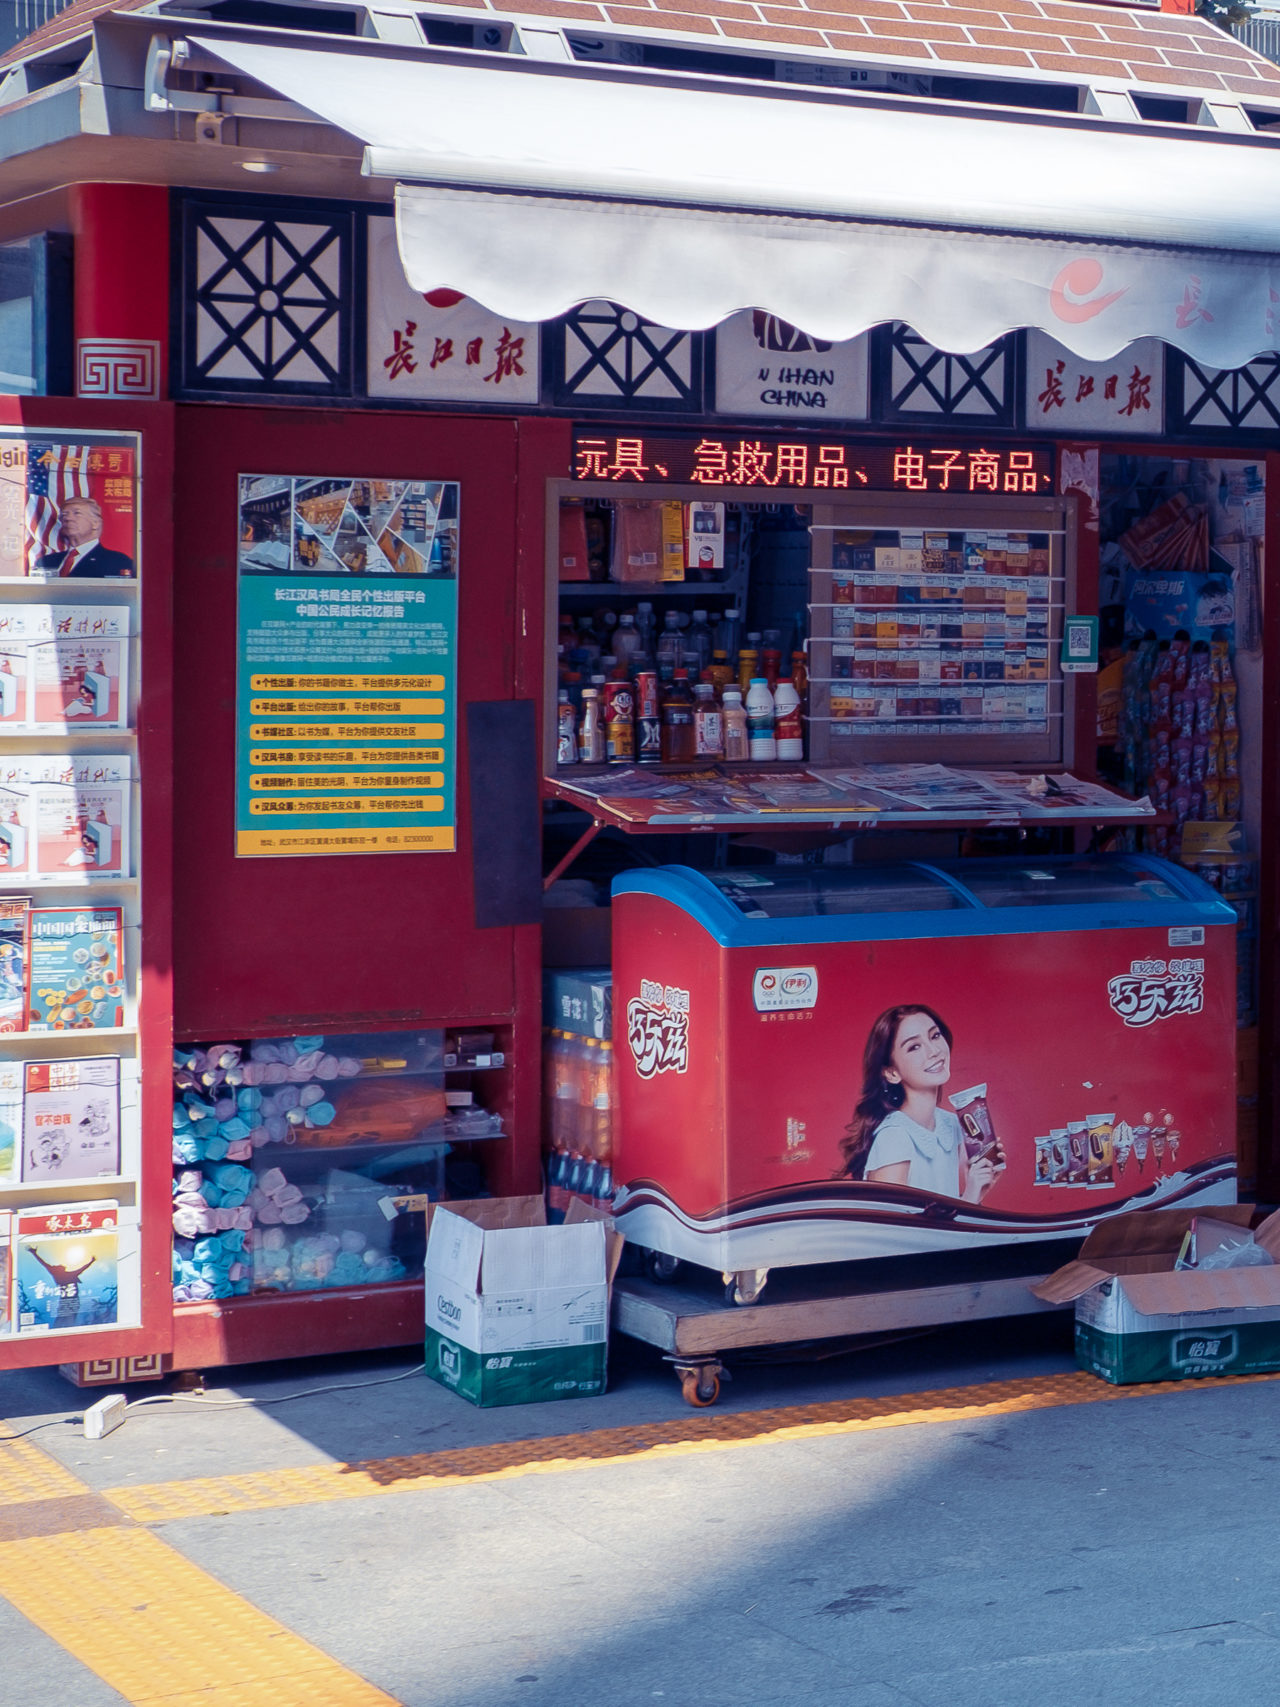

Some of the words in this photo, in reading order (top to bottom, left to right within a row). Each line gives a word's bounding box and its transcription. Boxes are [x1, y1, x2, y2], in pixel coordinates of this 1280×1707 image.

[760, 389, 828, 408] CHINA
[275, 588, 426, 603] 长江汉风书局全民个性出版平台
[296, 604, 405, 618] 中国公民成长记忆报告
[785, 979, 808, 990] 伊利
[1108, 974, 1204, 1028] 巧乐兹
[627, 999, 689, 1080] 巧乐兹
